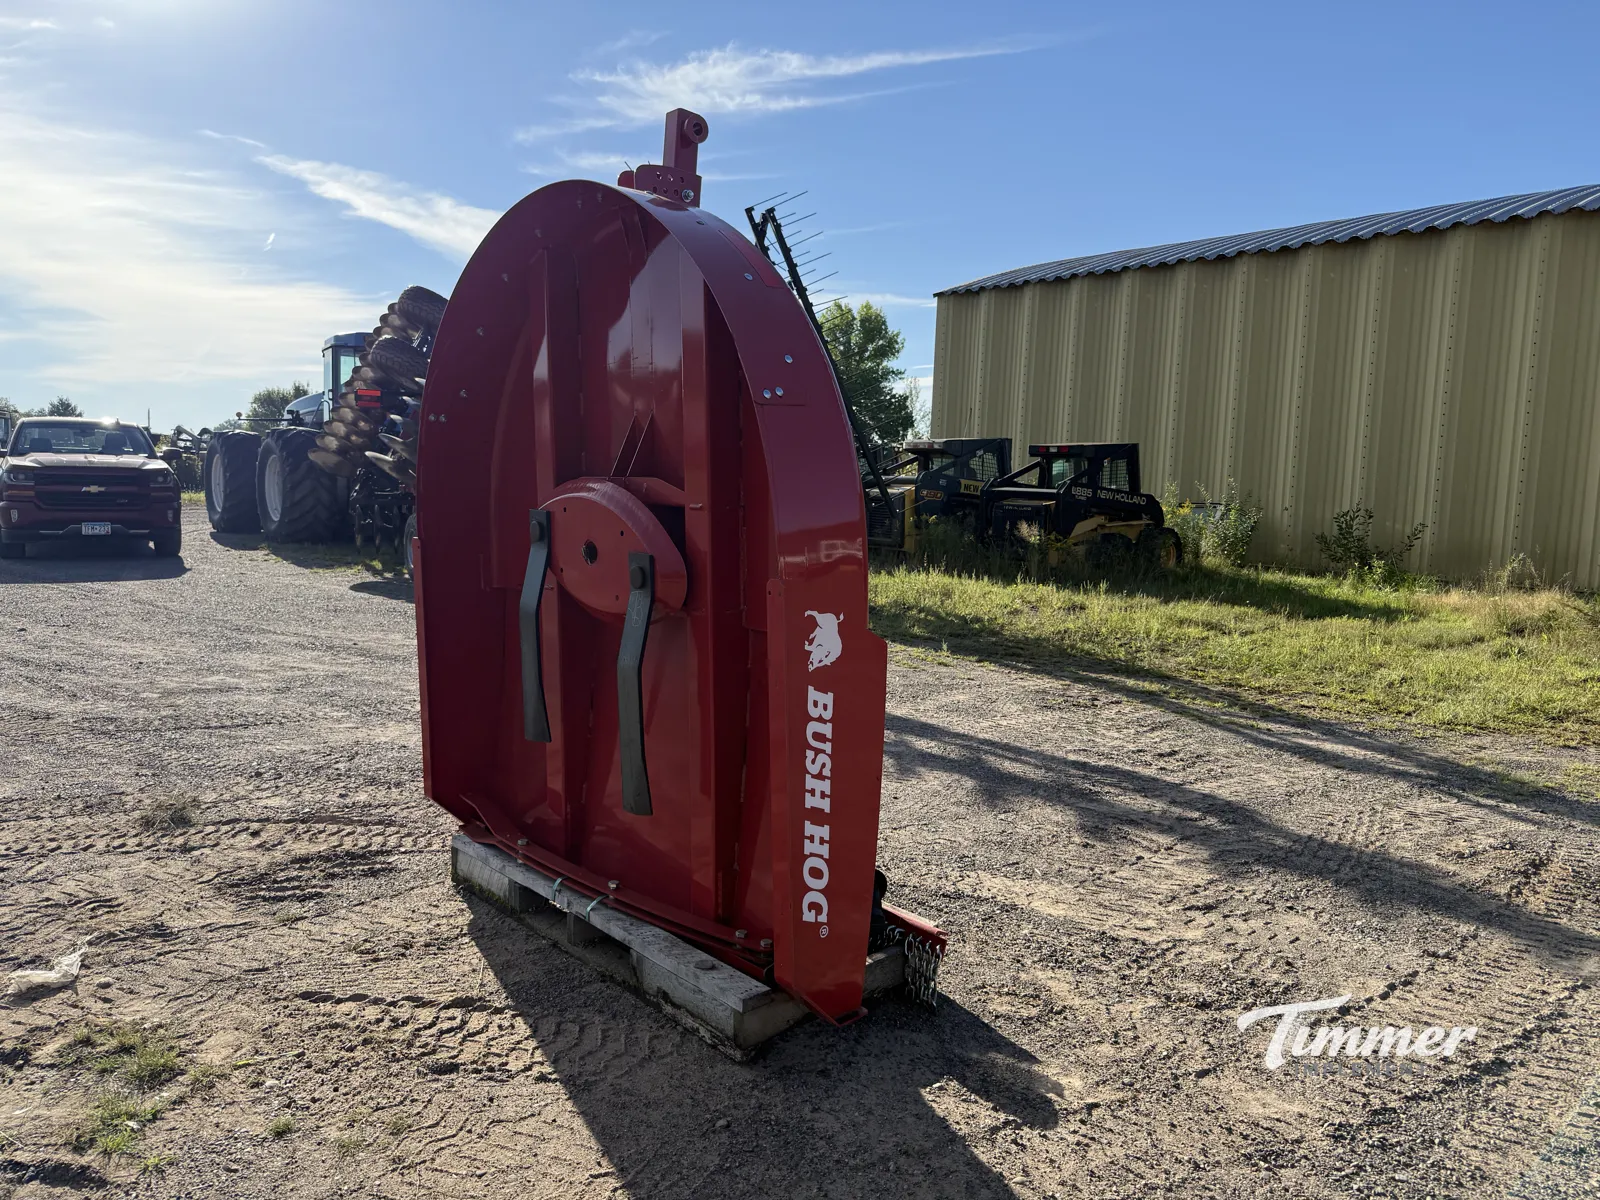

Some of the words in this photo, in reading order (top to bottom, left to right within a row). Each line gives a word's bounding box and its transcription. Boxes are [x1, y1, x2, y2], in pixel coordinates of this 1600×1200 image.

[963, 484, 980, 493] NEW
[1096, 489, 1115, 500] NEW
[1114, 492, 1147, 505] HOLLAND
[805, 686, 834, 813] BUSH
